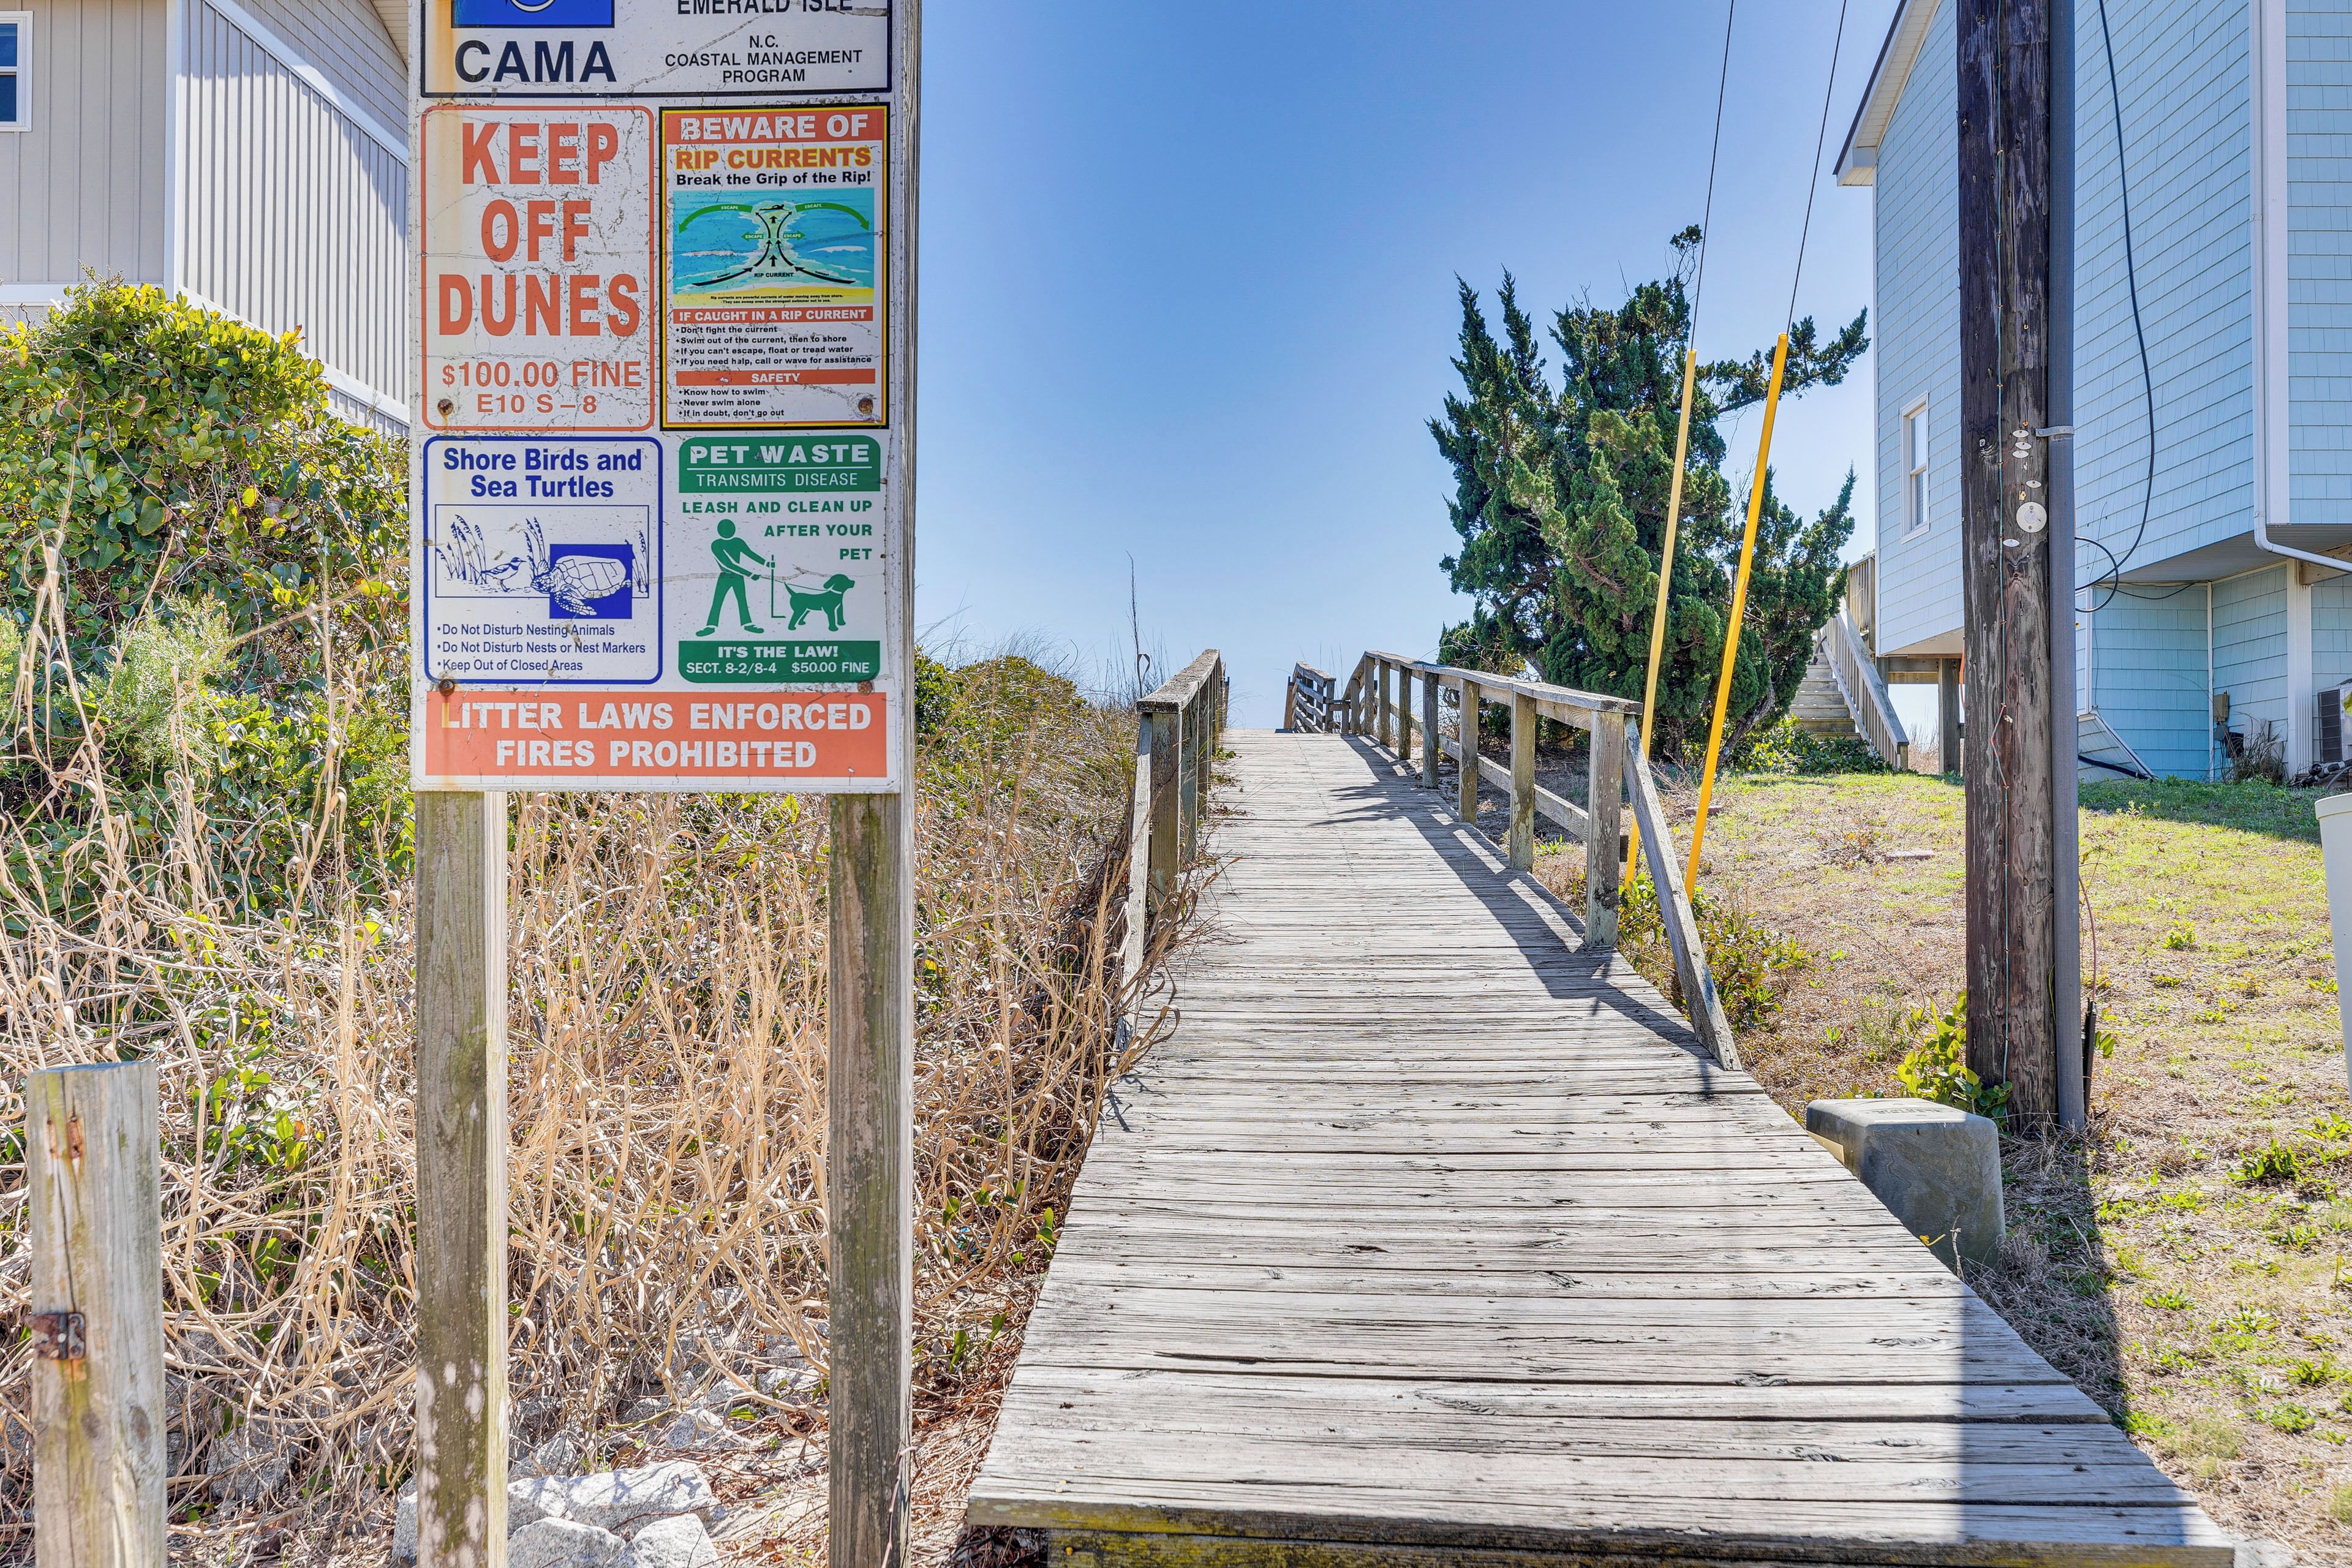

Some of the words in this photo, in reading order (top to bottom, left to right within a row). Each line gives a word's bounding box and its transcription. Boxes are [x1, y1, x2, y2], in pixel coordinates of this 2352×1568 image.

[677, 0, 790, 14] EMERALD
[749, 35, 778, 48] N.C.
[455, 40, 617, 83] CAMA
[665, 53, 742, 66] COASTAL
[747, 50, 862, 66] MANAGEMENT
[723, 69, 805, 83] PROGRAM
[680, 116, 816, 140] BEWARE
[827, 114, 869, 138] OF
[462, 123, 619, 184] KEEP
[676, 149, 719, 170] RIP
[727, 146, 872, 169] CURRENTS
[676, 173, 722, 185] Break
[727, 173, 751, 185] the
[756, 173, 788, 186] Grip
[793, 172, 808, 184] of
[812, 172, 837, 183] the
[842, 170, 871, 183] Rip!
[481, 199, 591, 262] OFF
[439, 273, 641, 337] DUNES
[679, 312, 692, 322] IF
[695, 311, 748, 321] CAUGHT
[752, 311, 765, 320] IN
[769, 311, 778, 320] A
[781, 310, 802, 320] RIP
[805, 309, 867, 319] CURRENT
[442, 361, 558, 388] $100.00
[572, 361, 642, 387] FINE
[751, 373, 801, 383] SAFETY
[477, 394, 525, 413] E10
[443, 448, 516, 470] Shore
[525, 448, 589, 471] Birds
[597, 448, 642, 471] and
[690, 445, 750, 464] PET
[760, 444, 870, 464] WASTE
[470, 475, 518, 497] Sea
[525, 475, 614, 497] Turtles
[696, 473, 786, 487] TRANSMITS
[795, 472, 858, 486] DISEASE
[682, 502, 738, 513] LEASH
[746, 501, 781, 513] AND
[788, 500, 844, 513] CLEAN
[850, 500, 873, 512] UP
[764, 525, 820, 537] AFTER
[826, 524, 873, 537] YOUR
[840, 548, 873, 560] PET
[442, 624, 458, 635] Do
[461, 624, 480, 635] Not
[483, 624, 523, 635] Disturb
[526, 624, 568, 638] Nesting
[571, 624, 615, 635] Animals
[442, 641, 458, 653] Do
[461, 641, 480, 653] Not
[483, 641, 523, 653] Disturb
[526, 641, 557, 653] Nests
[560, 644, 572, 653] or
[574, 641, 600, 653] Nest
[603, 641, 646, 653] Markers
[718, 646, 748, 658] IT'S
[753, 646, 786, 658] THE
[794, 646, 839, 658] LAW!
[443, 659, 470, 671] Keep
[473, 659, 493, 670] Out
[496, 658, 507, 670] of
[510, 659, 548, 671] Closed
[552, 660, 583, 671] Areas
[686, 662, 722, 674] SECT.
[725, 662, 777, 676] 8-2/8-4
[791, 662, 837, 673] $50.00
[842, 662, 870, 673] FINE
[441, 702, 562, 729] LITTER
[579, 702, 674, 730] LAWS
[690, 702, 872, 731] ENFORCED
[496, 739, 596, 768] FIRES
[609, 739, 818, 768] PROHIBITED
